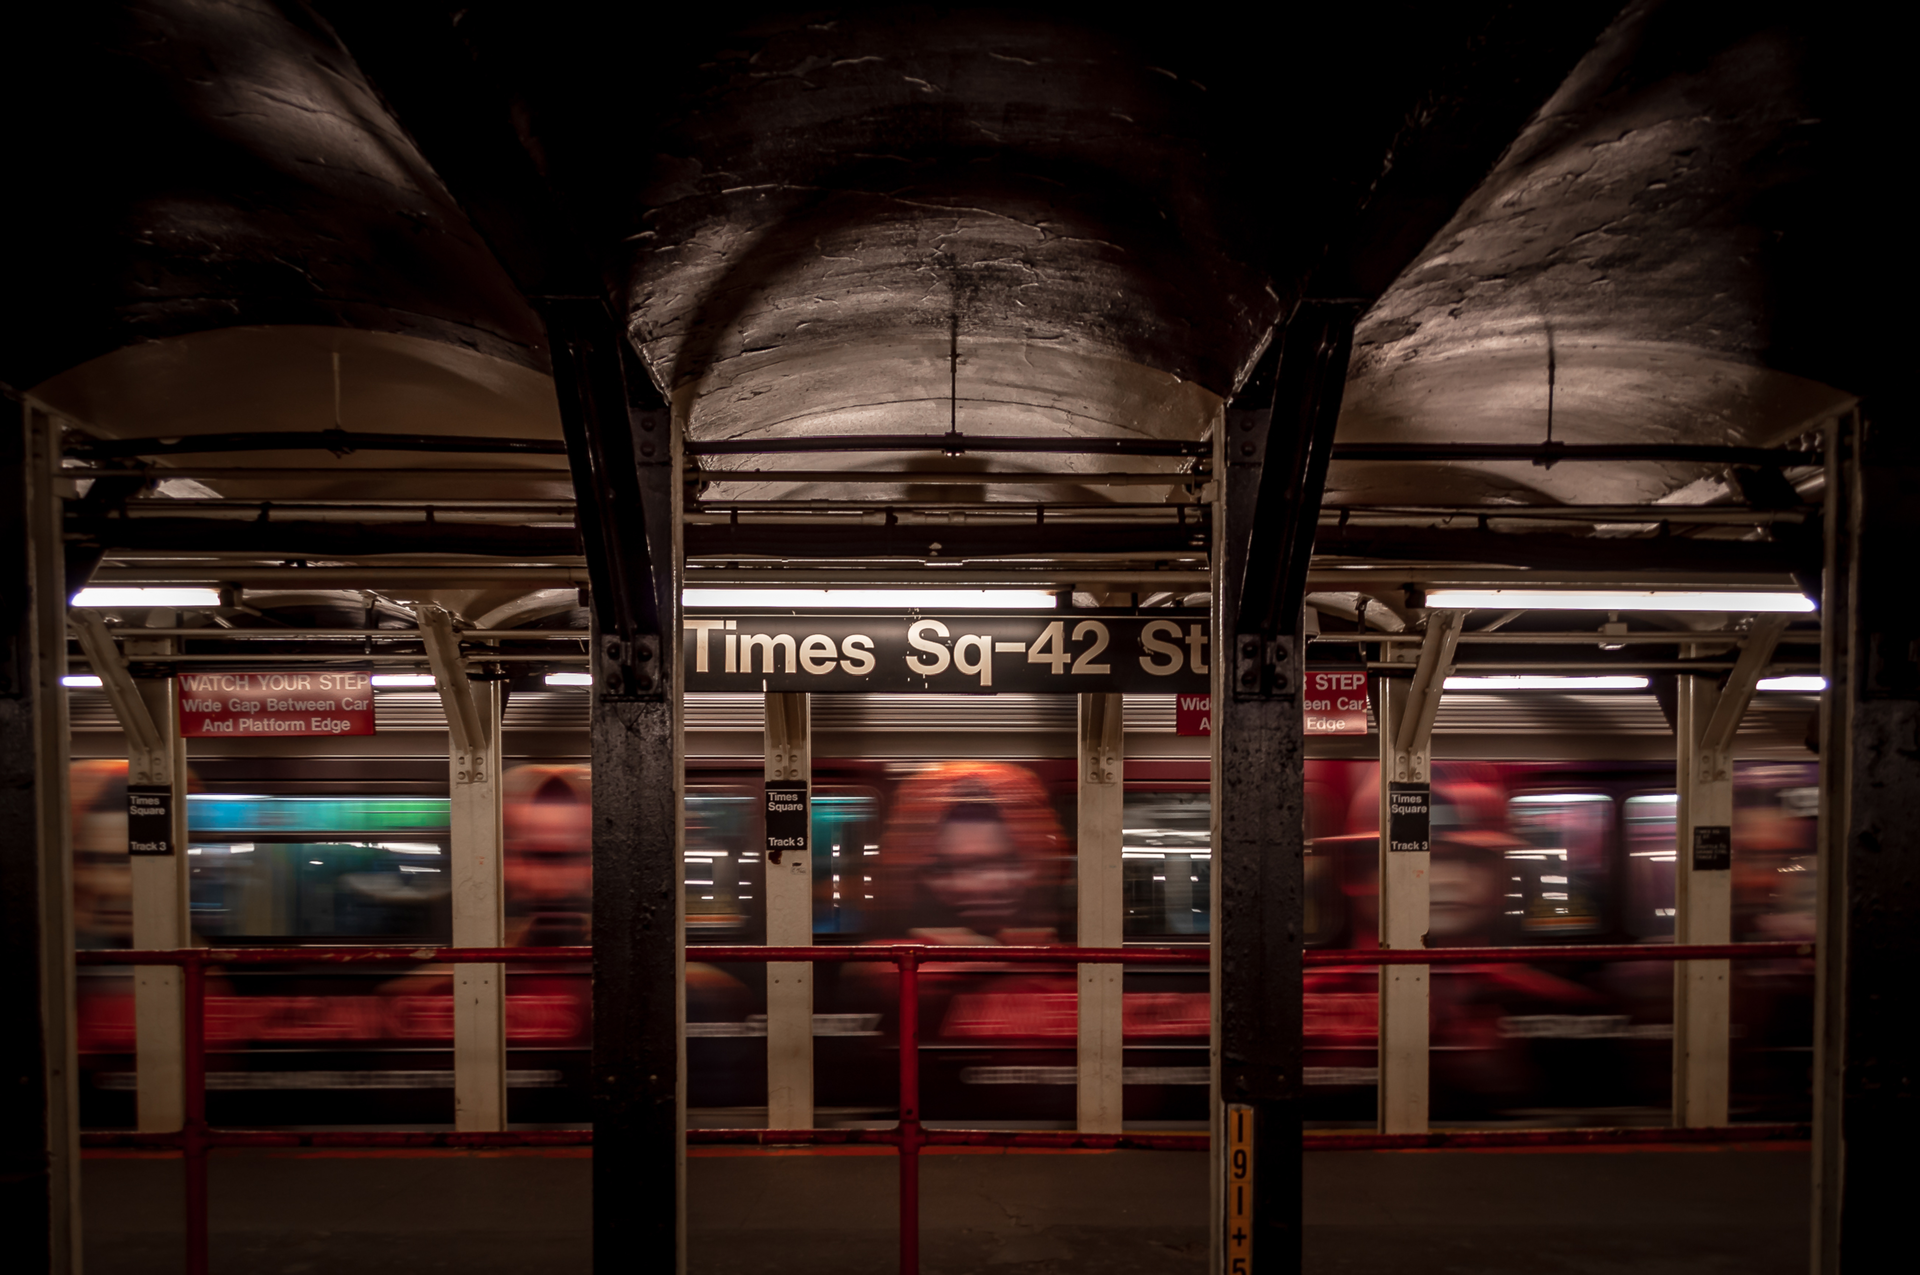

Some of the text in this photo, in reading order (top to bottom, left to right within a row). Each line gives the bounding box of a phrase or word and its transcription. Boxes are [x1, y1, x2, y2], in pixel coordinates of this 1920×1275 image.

[683, 619, 1210, 686] Times Sq-42 St
[180, 674, 370, 692] WATCH YOUR STEP
[1315, 674, 1366, 690] STEP
[183, 697, 370, 715] Wide Gap Between Car
[1181, 697, 1211, 711] Wid
[1336, 697, 1364, 711] Car
[202, 717, 351, 734] And Platform Edge
[1306, 717, 1346, 733] Edge
[129, 795, 160, 806] Times
[768, 792, 798, 802] Times
[1391, 794, 1422, 804] Times
[129, 805, 166, 817] Square
[768, 802, 804, 813] Square
[1391, 804, 1428, 816] Square
[130, 841, 167, 851] Track 3
[768, 837, 804, 847] Track 3
[1391, 840, 1429, 851] Track 3
